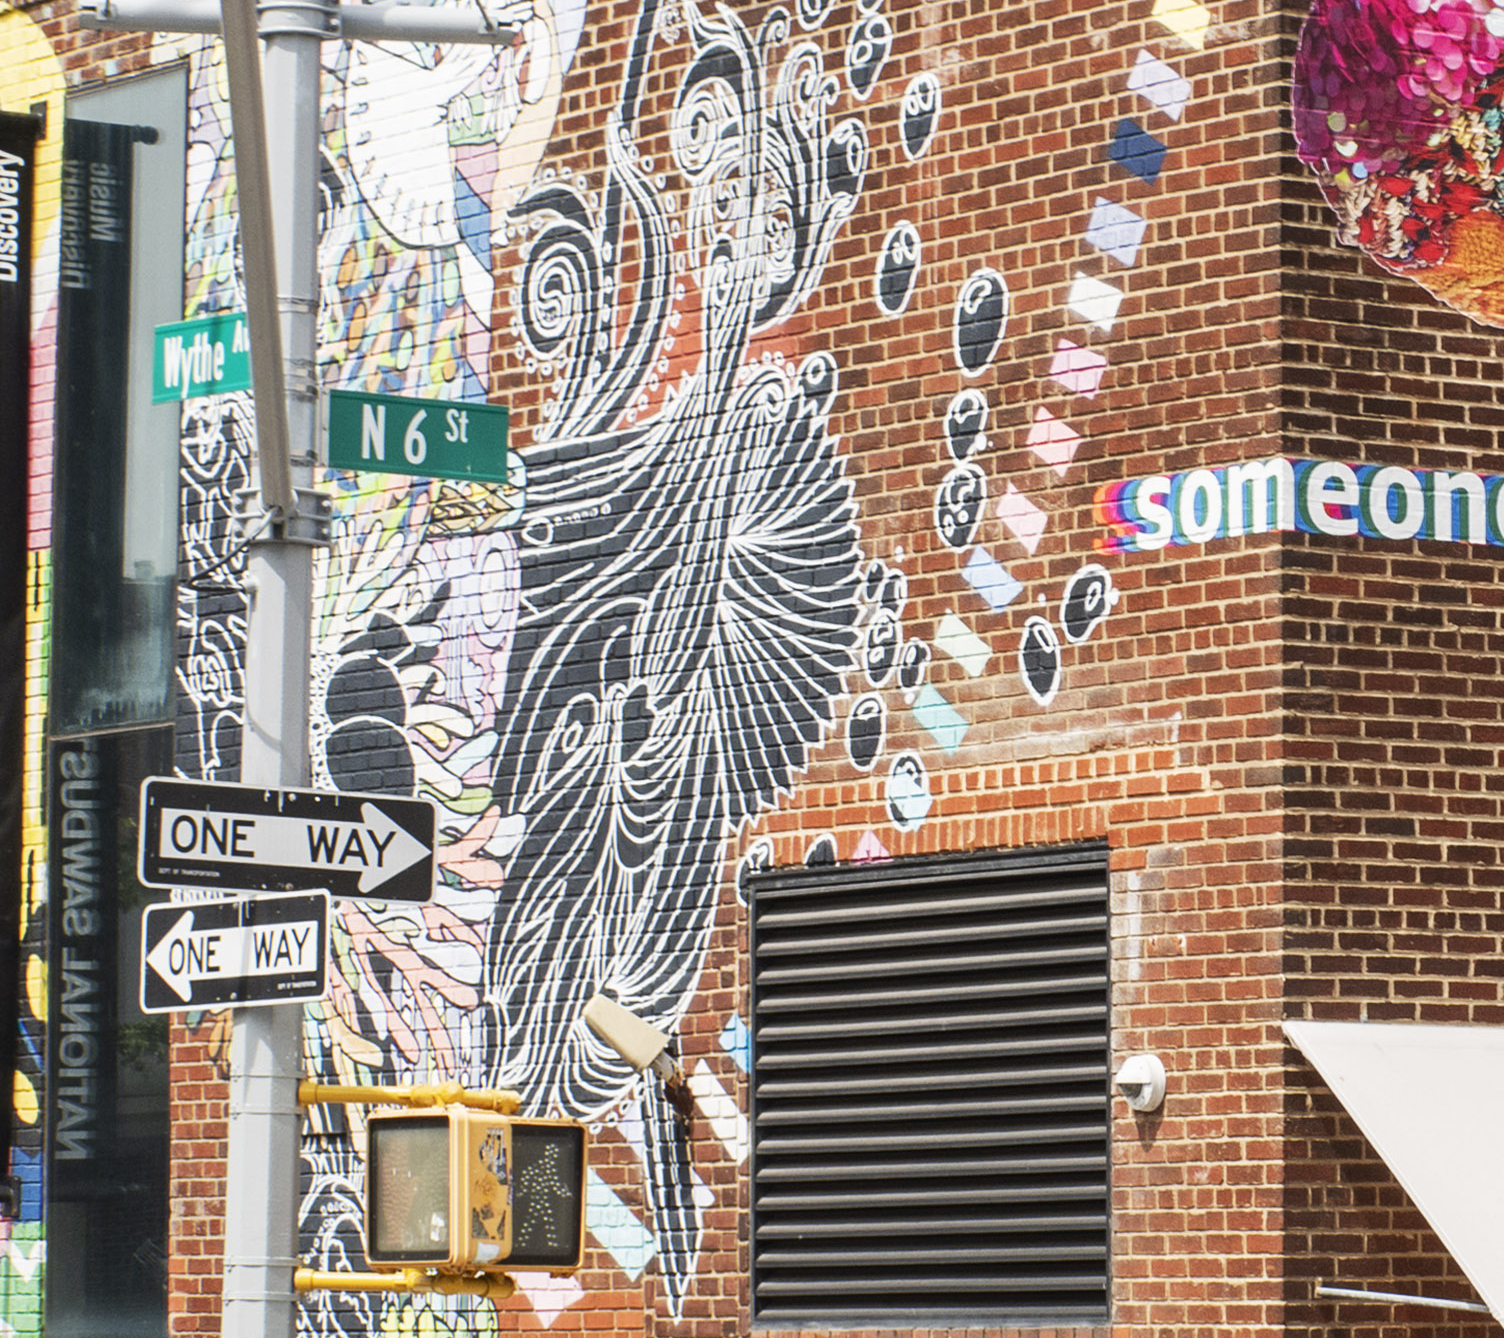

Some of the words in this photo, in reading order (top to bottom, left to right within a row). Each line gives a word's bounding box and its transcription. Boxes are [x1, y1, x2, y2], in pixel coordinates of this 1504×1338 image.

[164, 330, 225, 398] Wythe
[361, 404, 386, 461] N
[404, 409, 427, 465] 6
[445, 408, 469, 443] St
[171, 815, 255, 858] ONE
[307, 825, 396, 867] WAY
[169, 936, 221, 975] ONE
[253, 927, 310, 969] WAY
